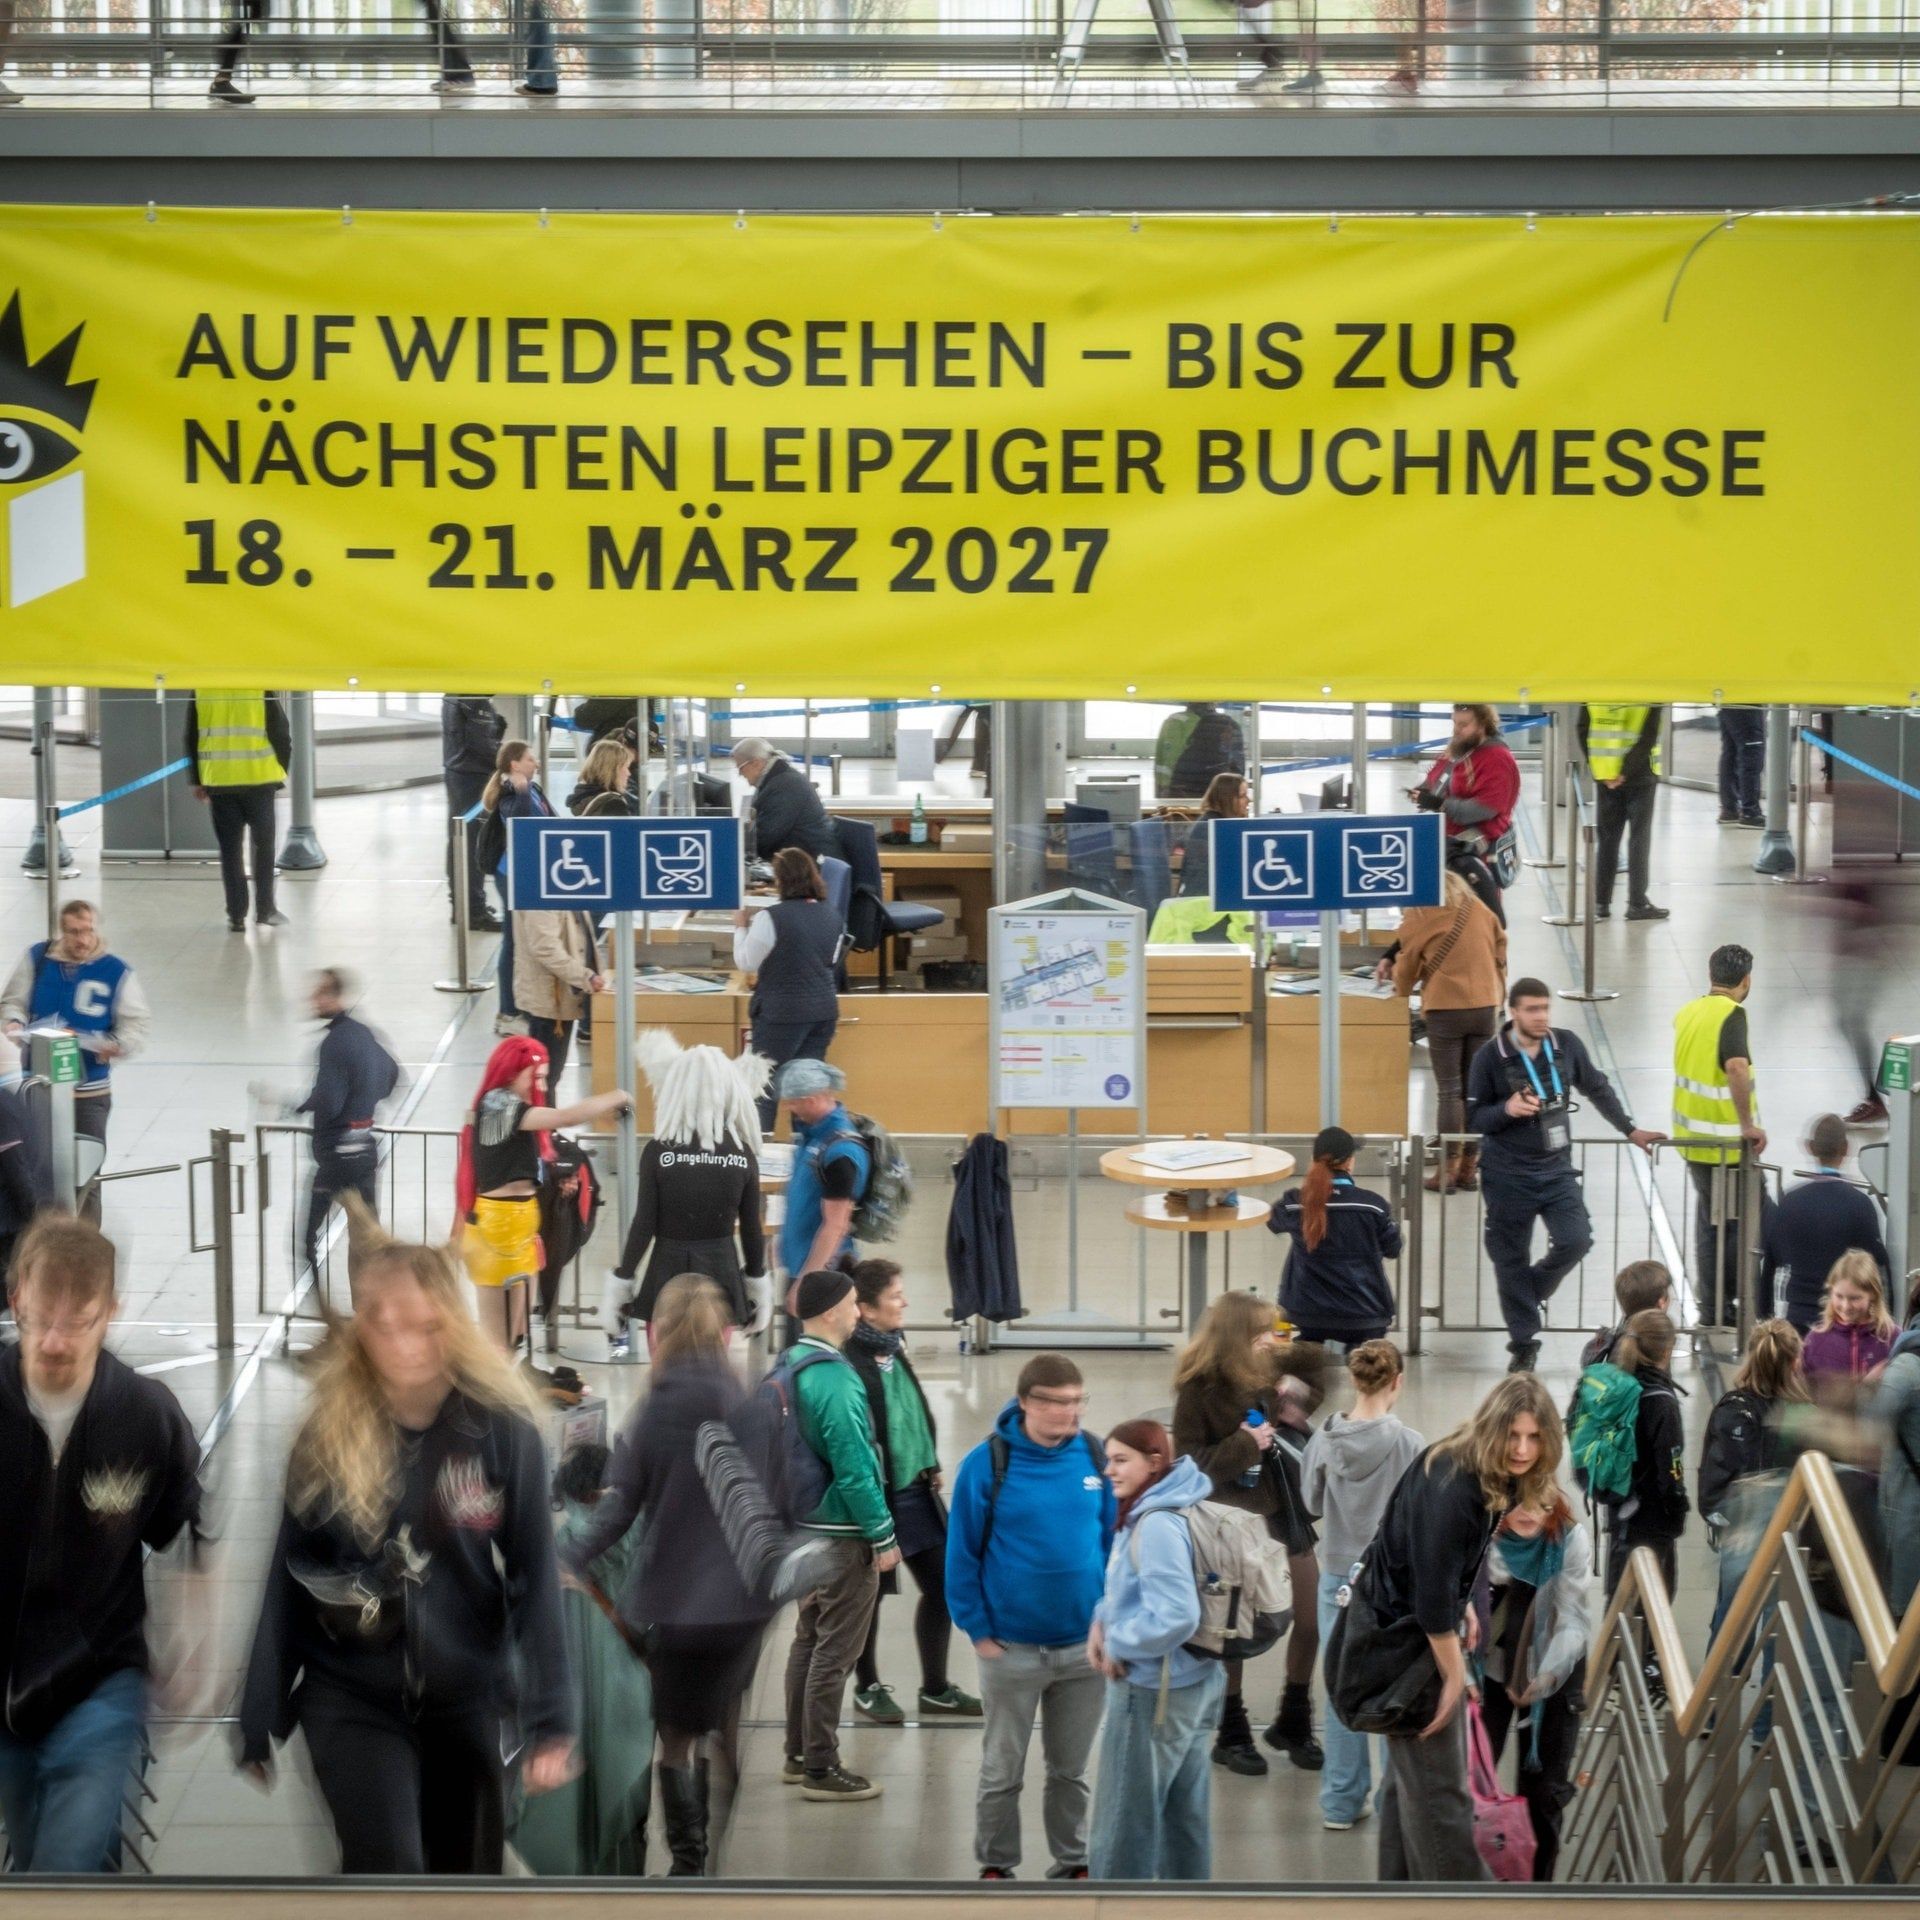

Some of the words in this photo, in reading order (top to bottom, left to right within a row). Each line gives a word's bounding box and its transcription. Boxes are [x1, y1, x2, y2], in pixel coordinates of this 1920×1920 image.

[175, 312, 356, 382] AUF
[375, 315, 1046, 388] WIEDERSEHEN
[1167, 322, 1304, 391] BIS
[1333, 322, 1519, 390] ZUR
[183, 397, 677, 493] NÄCHSTEN
[713, 426, 1166, 496] LEIPZIGER
[1197, 428, 1766, 498] BUCHMESSE
[184, 518, 313, 588] 18.
[428, 522, 555, 591] 21.
[588, 502, 858, 593] MÄRZ
[889, 526, 1109, 594] 2027
[73, 979, 111, 1017] C
[676, 1152, 748, 1169] angelfurry2023
